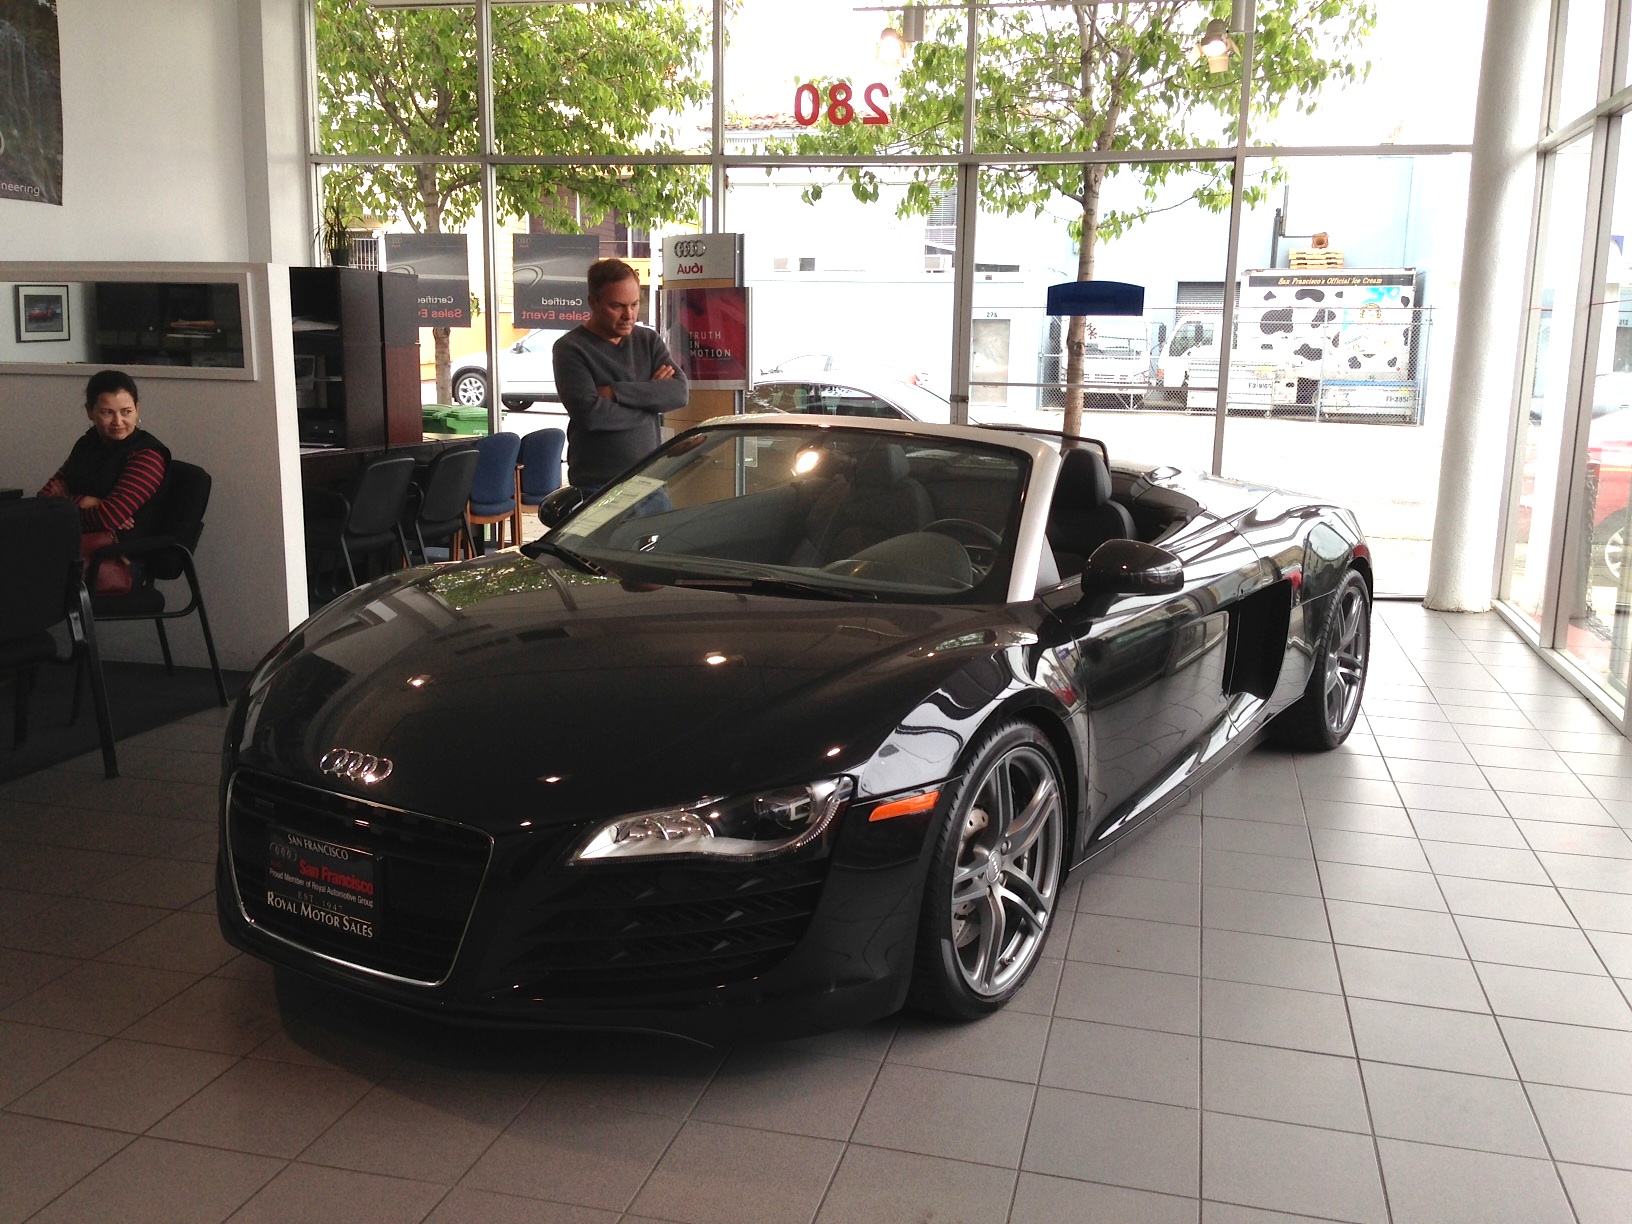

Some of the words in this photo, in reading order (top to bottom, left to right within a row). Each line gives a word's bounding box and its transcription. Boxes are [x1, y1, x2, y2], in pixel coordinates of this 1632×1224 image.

[677, 263, 704, 275] Audi
[1278, 277, 1290, 285] San
[1291, 277, 1326, 285] Francisco's
[1326, 277, 1350, 285] Official
[689, 331, 721, 340] TRUTH
[689, 341, 700, 349] IN
[690, 349, 731, 357] MOTION
[288, 833, 303, 847] SAN
[303, 839, 349, 860] FRANCISCO
[299, 859, 319, 879] San
[321, 866, 374, 896] Francisco
[269, 868, 283, 880] Proud
[284, 872, 305, 886] Member
[305, 880, 311, 888] of
[311, 881, 326, 894] Royal
[326, 886, 357, 903] Automotive
[357, 895, 374, 908] Group
[322, 900, 343, 912] 1947
[267, 891, 298, 914] ROYAL
[300, 902, 340, 928] MOTOR
[342, 915, 373, 938] SALES
